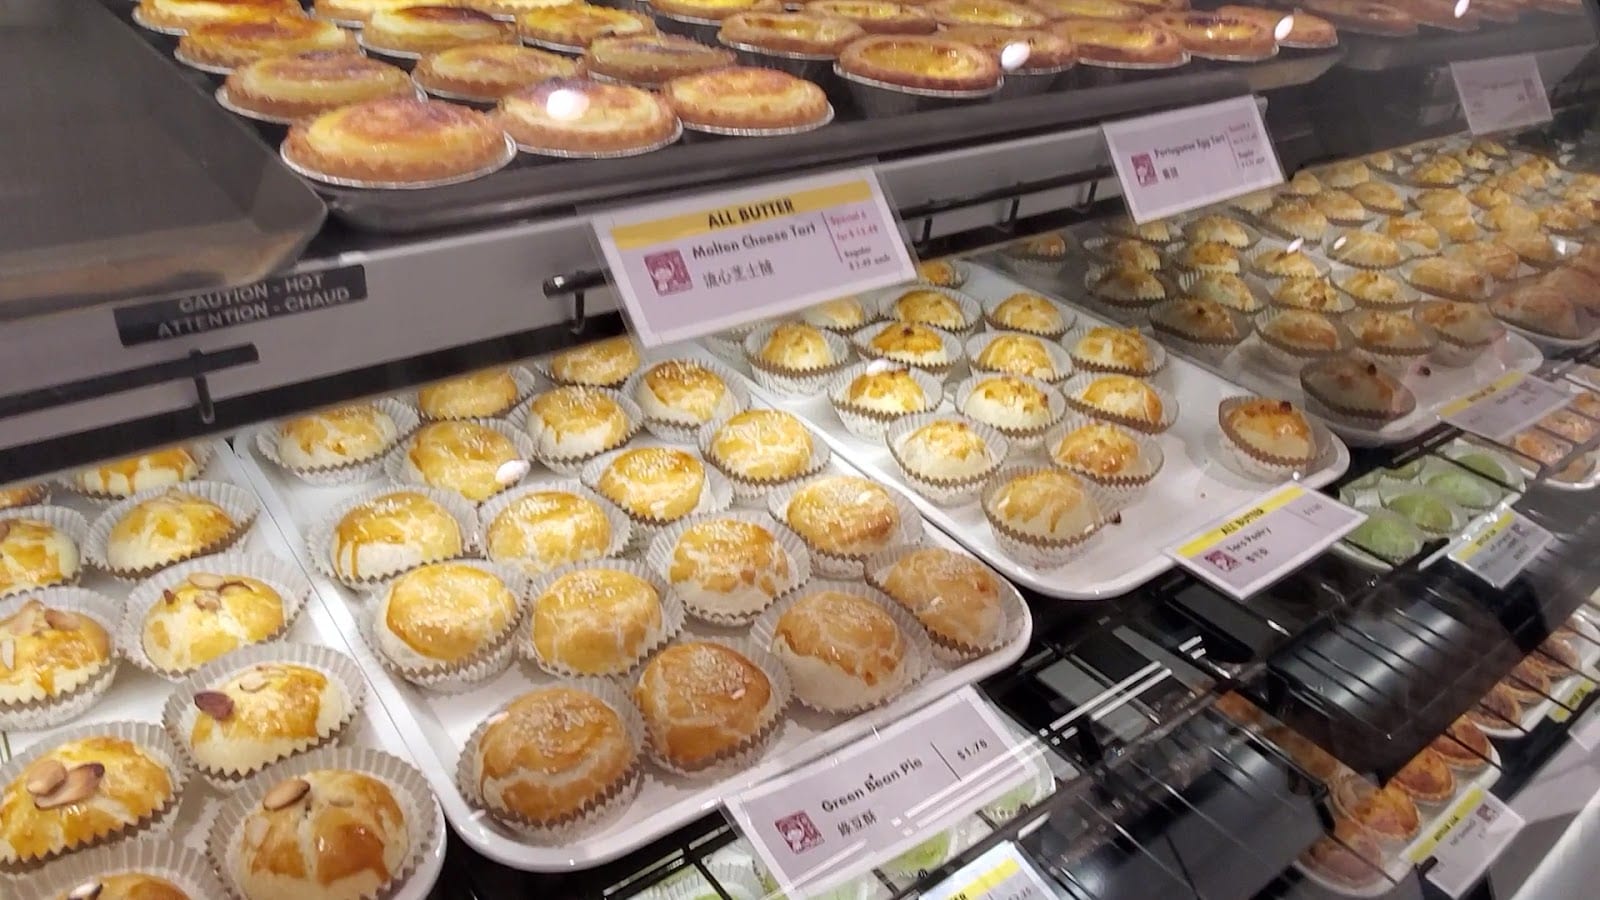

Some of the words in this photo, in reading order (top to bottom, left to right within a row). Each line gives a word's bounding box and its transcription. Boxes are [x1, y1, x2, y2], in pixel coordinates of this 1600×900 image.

[1154, 143, 1196, 159] Portuguese
[1196, 136, 1211, 150] Egg
[1211, 134, 1225, 145] Tart
[708, 212, 734, 230] ALL
[740, 197, 796, 222] BUTTER
[692, 241, 741, 260] Molten
[742, 230, 789, 249] Cheese
[791, 222, 817, 239] Tart
[179, 283, 268, 313] CAUTION
[285, 274, 325, 292] HOT
[157, 302, 268, 338] ATTENTION
[285, 288, 350, 312] CHAUD
[822, 788, 865, 813] Green
[864, 770, 901, 793] Bean
[900, 757, 922, 776] Pie
